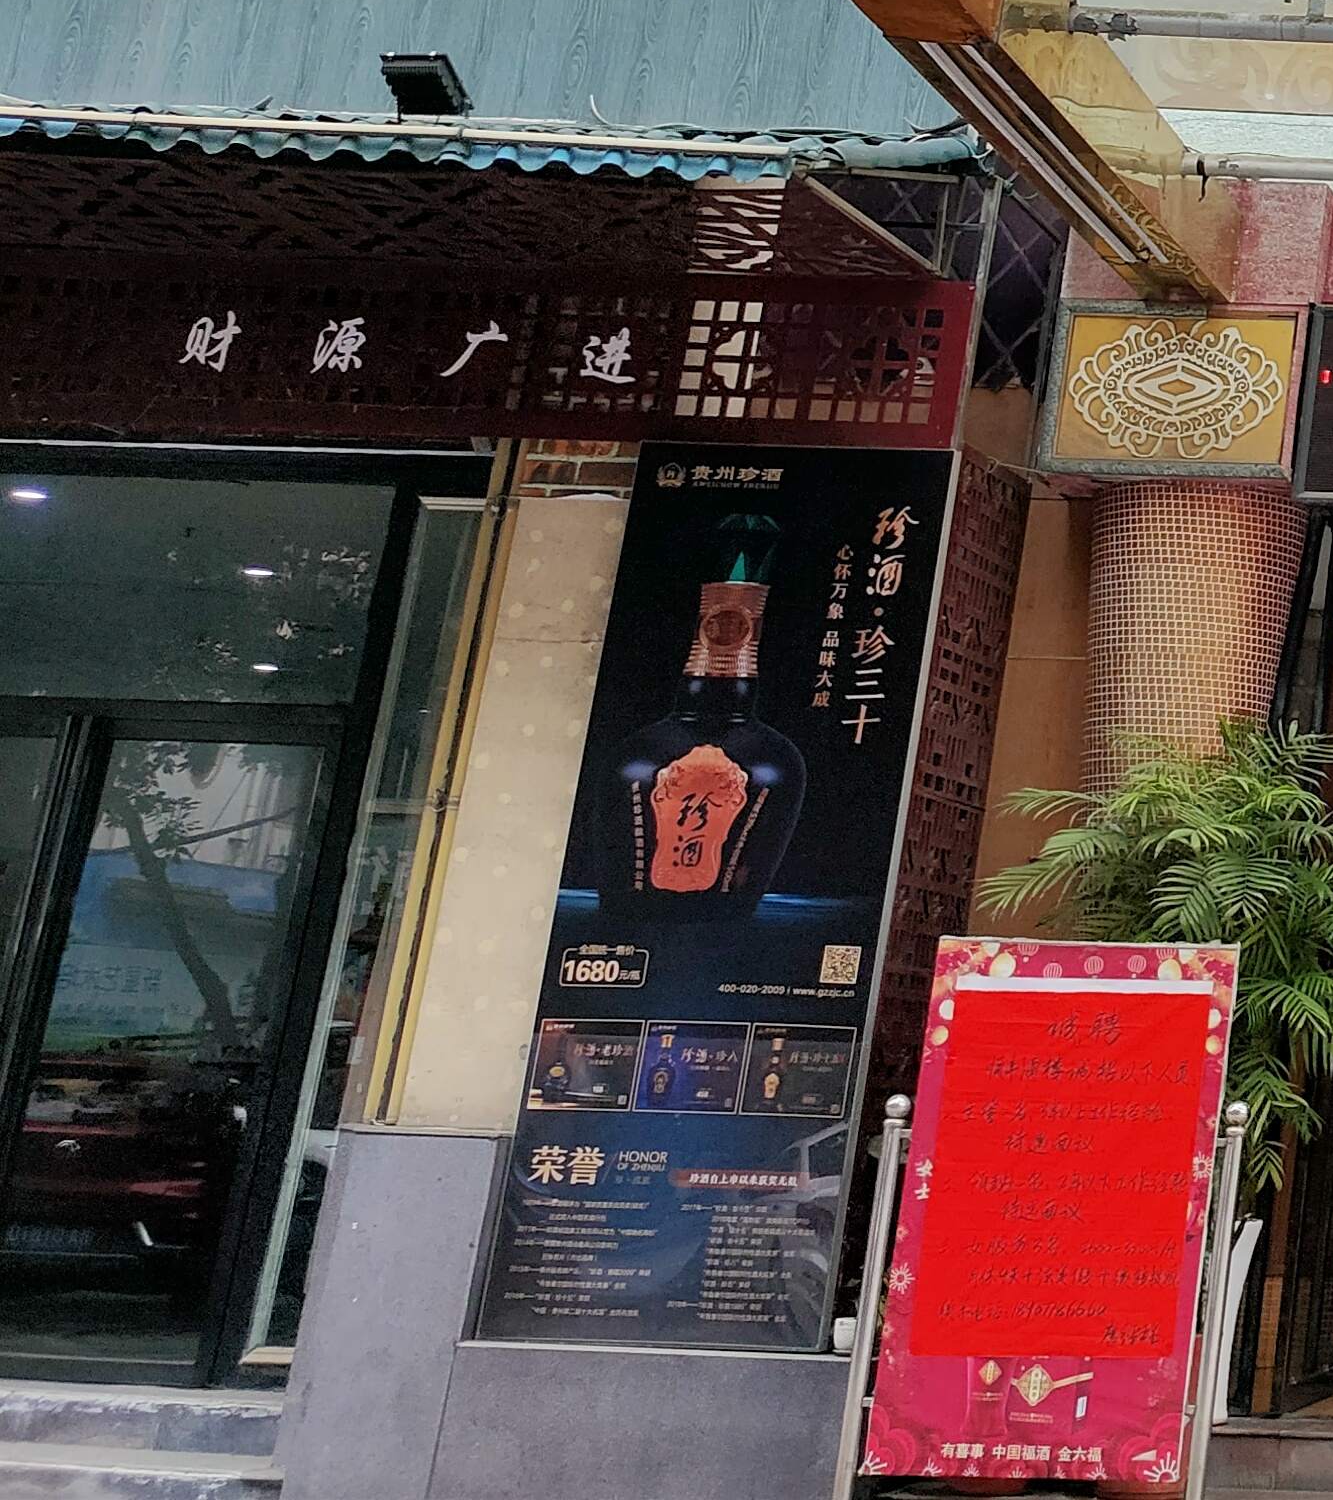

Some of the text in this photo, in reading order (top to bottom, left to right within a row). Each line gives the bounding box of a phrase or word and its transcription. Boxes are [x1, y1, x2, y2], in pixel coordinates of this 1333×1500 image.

[180, 311, 636, 384] 财源广进
[690, 464, 785, 482] 贵州珍酒
[811, 544, 855, 708] 心怀万象 品味大成
[718, 983, 786, 996] 400-020-2009
[527, 1145, 606, 1185] 荣誉
[618, 1150, 669, 1163] HONOR
[616, 1162, 666, 1173] OF ZHENJIU
[940, 1442, 1102, 1463] 有喜事 中国福酒 金六福
